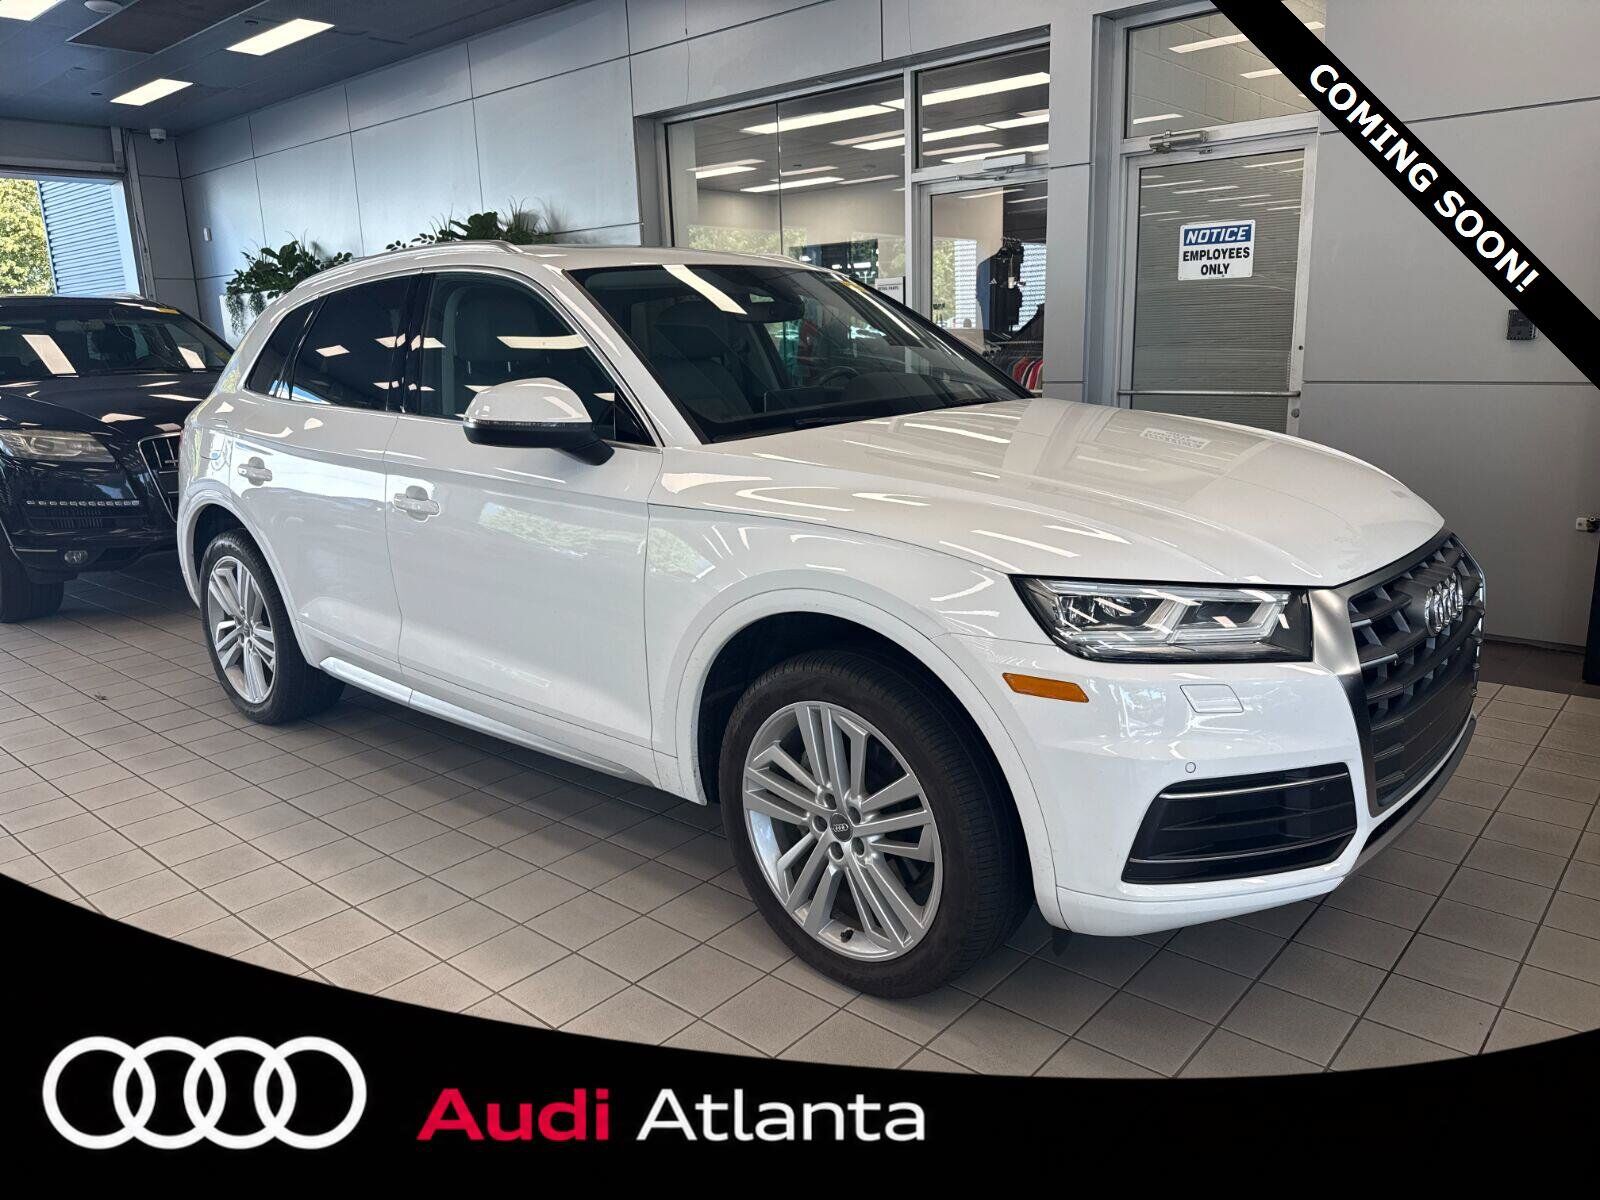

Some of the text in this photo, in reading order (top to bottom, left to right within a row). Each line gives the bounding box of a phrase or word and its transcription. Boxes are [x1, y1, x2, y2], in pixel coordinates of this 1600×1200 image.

[1185, 226, 1249, 244] NOTICE
[1182, 247, 1250, 262] EMPLOYEES
[1200, 263, 1230, 276] ONLY
